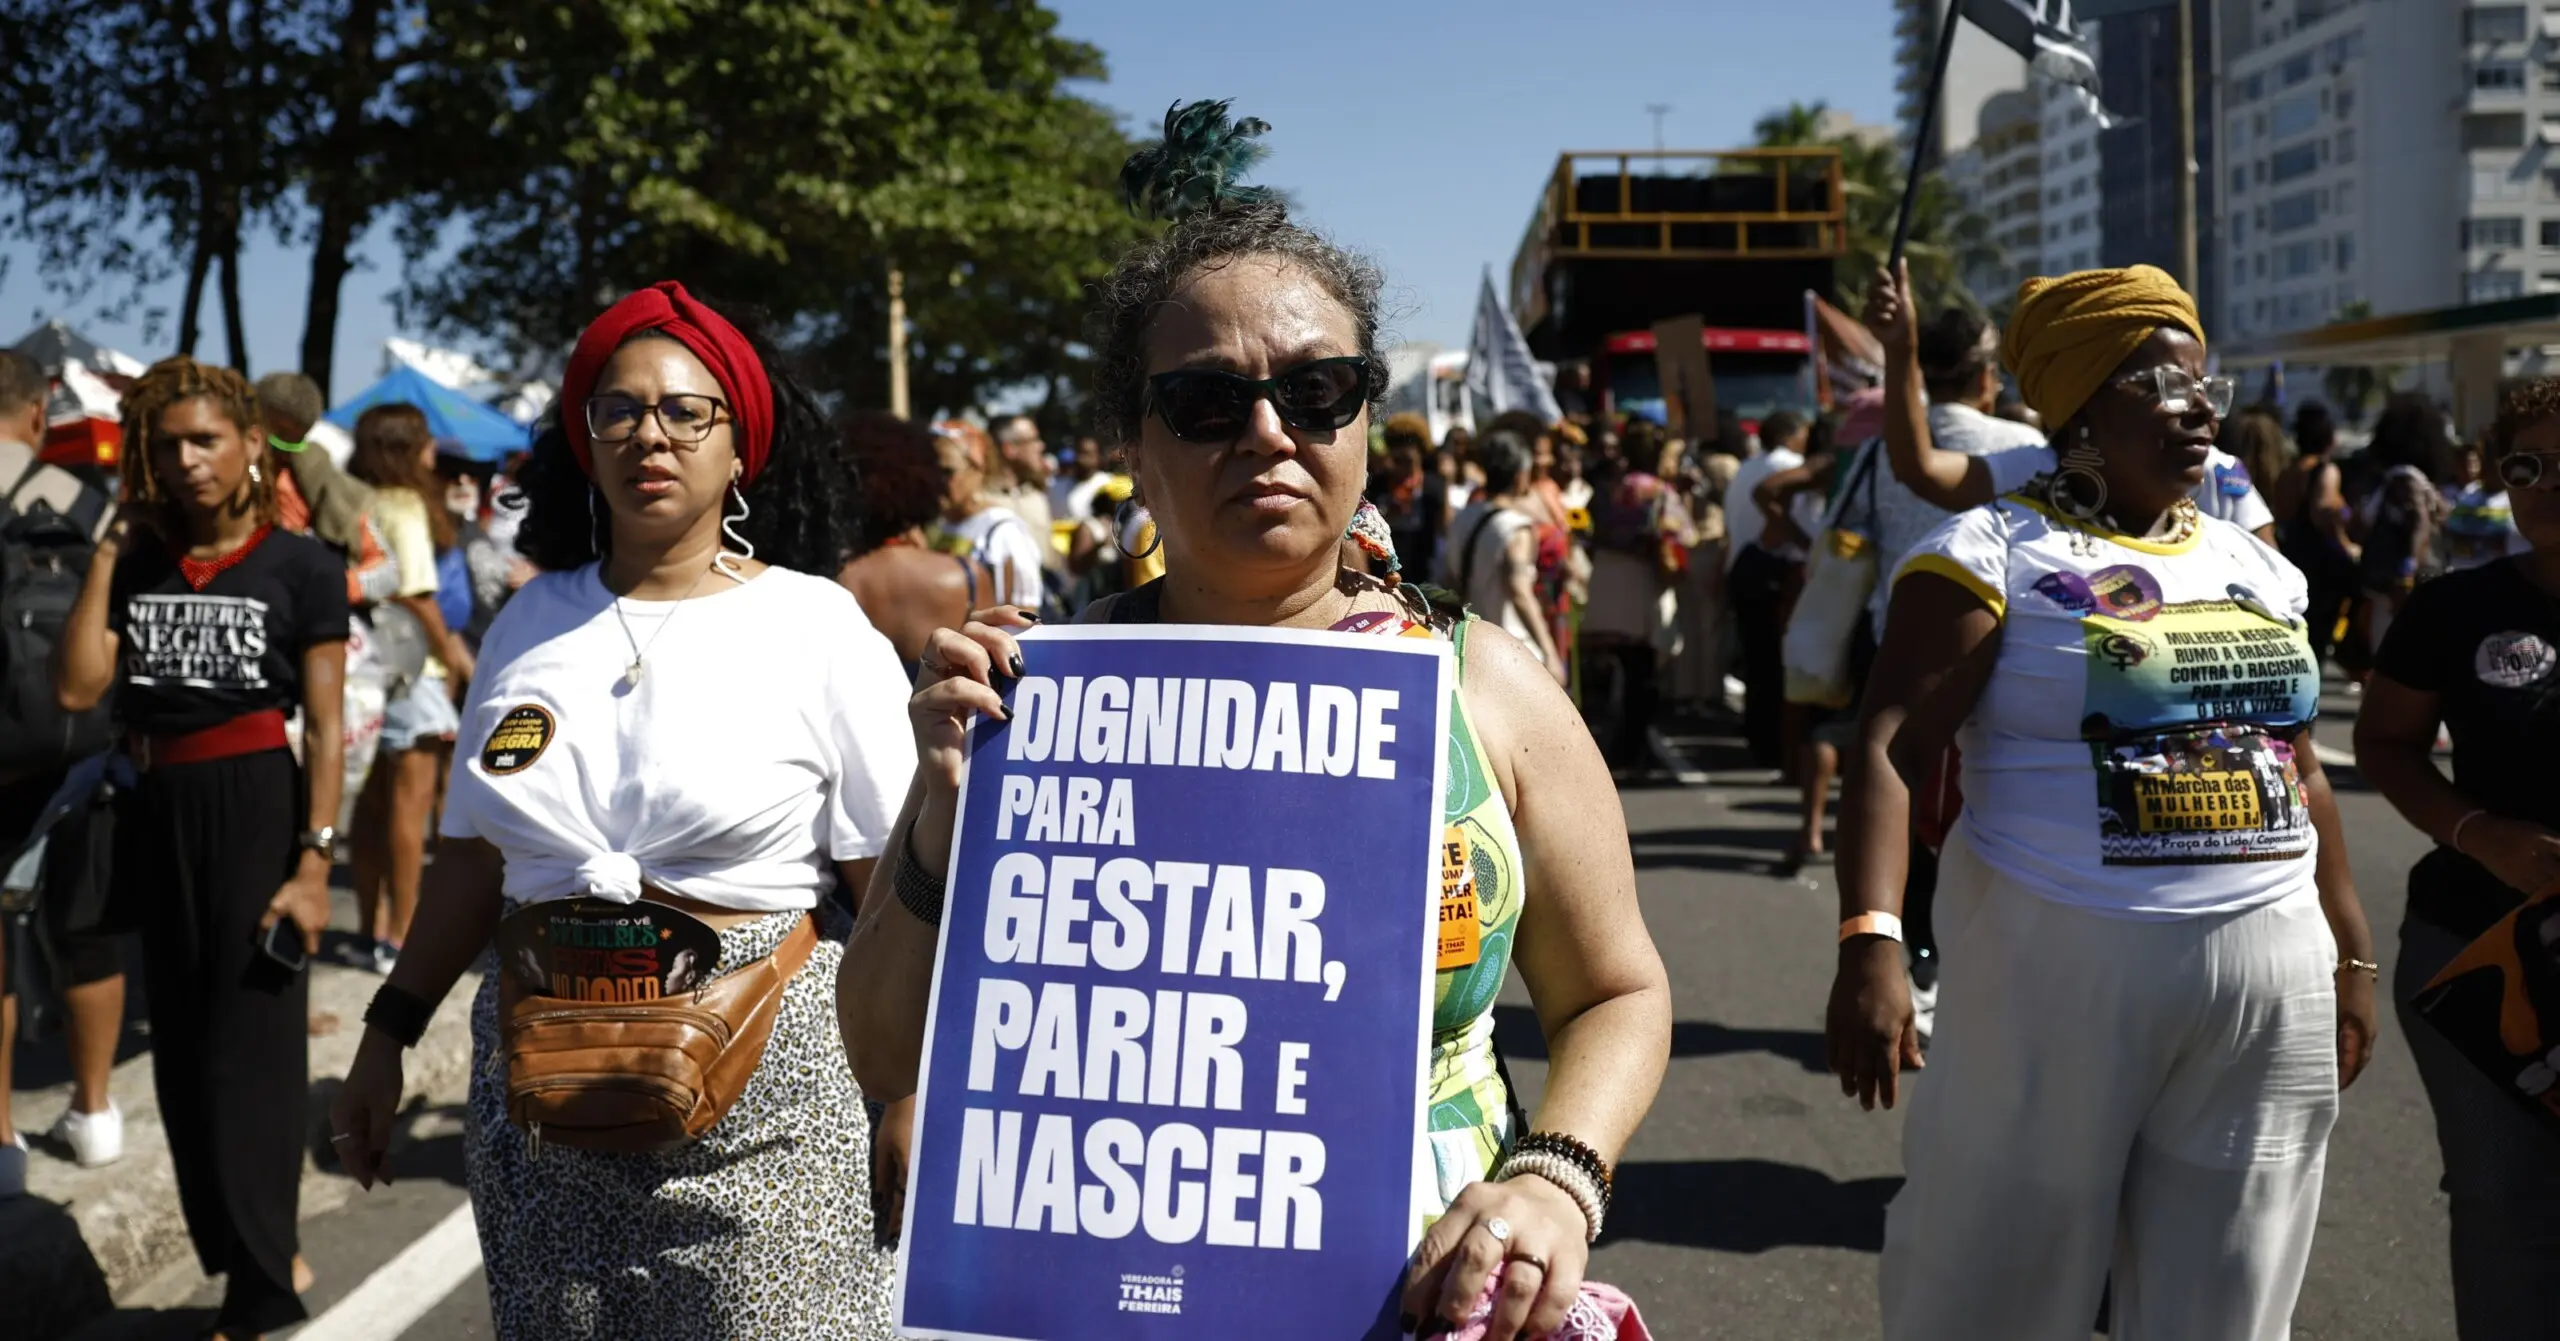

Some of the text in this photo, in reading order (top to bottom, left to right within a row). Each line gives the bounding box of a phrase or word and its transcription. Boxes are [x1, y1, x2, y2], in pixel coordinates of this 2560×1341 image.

[127, 623, 266, 657] NEGRAS
[2164, 627, 2290, 646] MULHERES NEGRAS
[2174, 647, 2219, 664] RUMO
[2222, 646, 2235, 661] A
[2170, 658, 2312, 684] CONTRA O RACISMO,
[2190, 678, 2299, 700] POR JUSTIÇA E
[2197, 697, 2292, 719] O BEM VIVER
[1006, 676, 1400, 781] DIGNIDADE
[487, 733, 542, 752] NEGRA
[2160, 776, 2222, 795] Marcha
[2224, 775, 2251, 793] das
[996, 775, 1136, 847] PARA
[2146, 794, 2251, 814] MULHERES
[2219, 812, 2238, 827] do
[2242, 811, 2260, 827] RJ
[2161, 835, 2201, 852] Praça
[1442, 843, 1463, 867] TE
[983, 852, 1348, 1001] GESTAR,
[967, 977, 1310, 1115] PARIR E
[953, 1107, 1327, 1251] NASCER
[1120, 1273, 1172, 1285] VEREADORA
[1119, 1283, 1183, 1302] THAIS
[1118, 1299, 1181, 1314] FERREIRA
